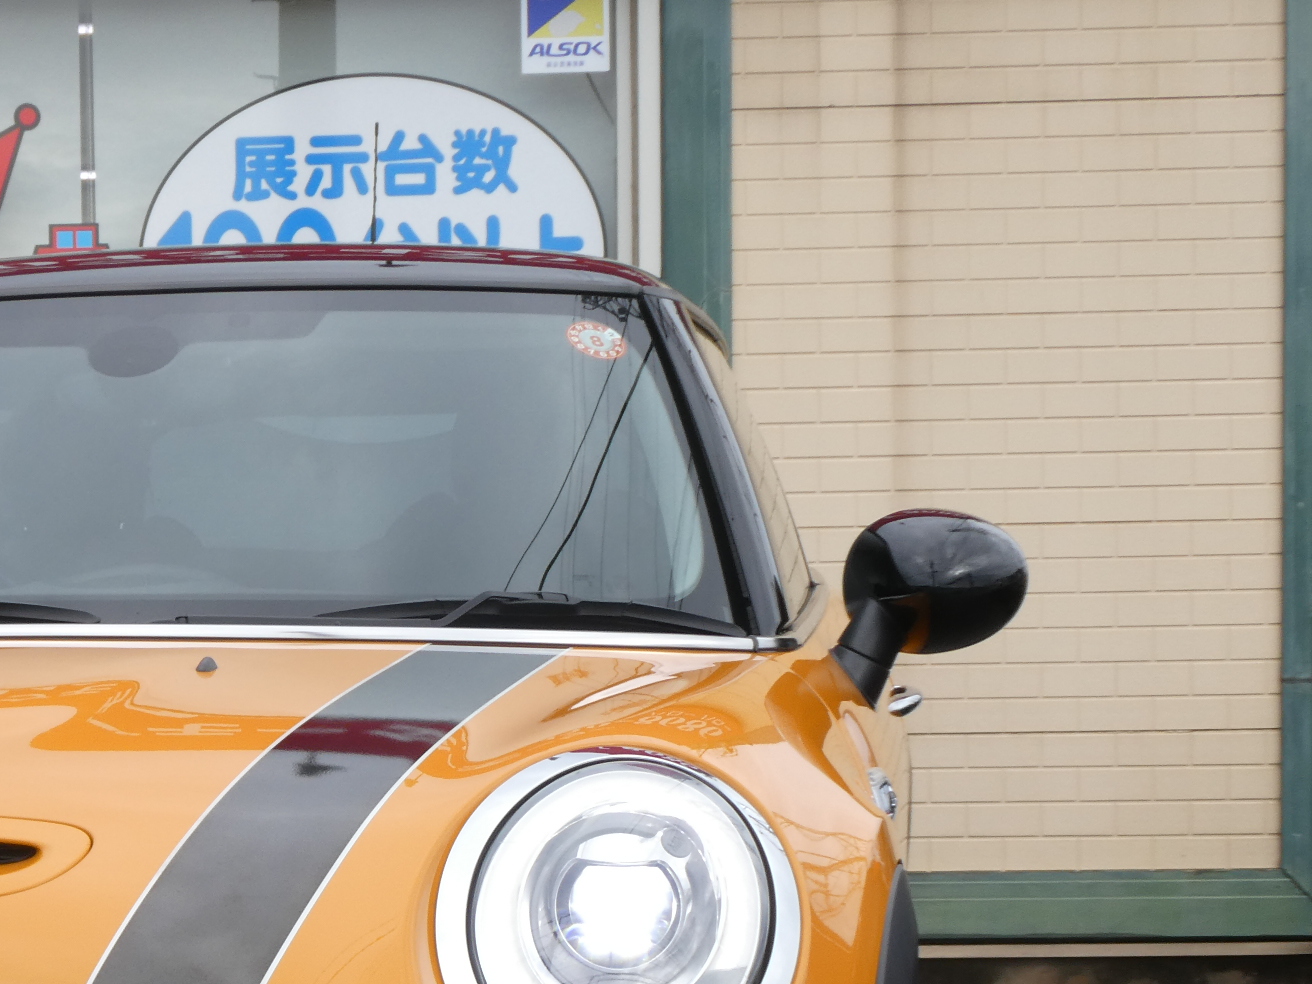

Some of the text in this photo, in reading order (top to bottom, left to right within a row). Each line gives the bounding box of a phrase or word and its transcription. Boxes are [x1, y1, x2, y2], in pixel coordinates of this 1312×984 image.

[528, 41, 604, 57] ALSOK
[232, 126, 519, 202] 展示台数
